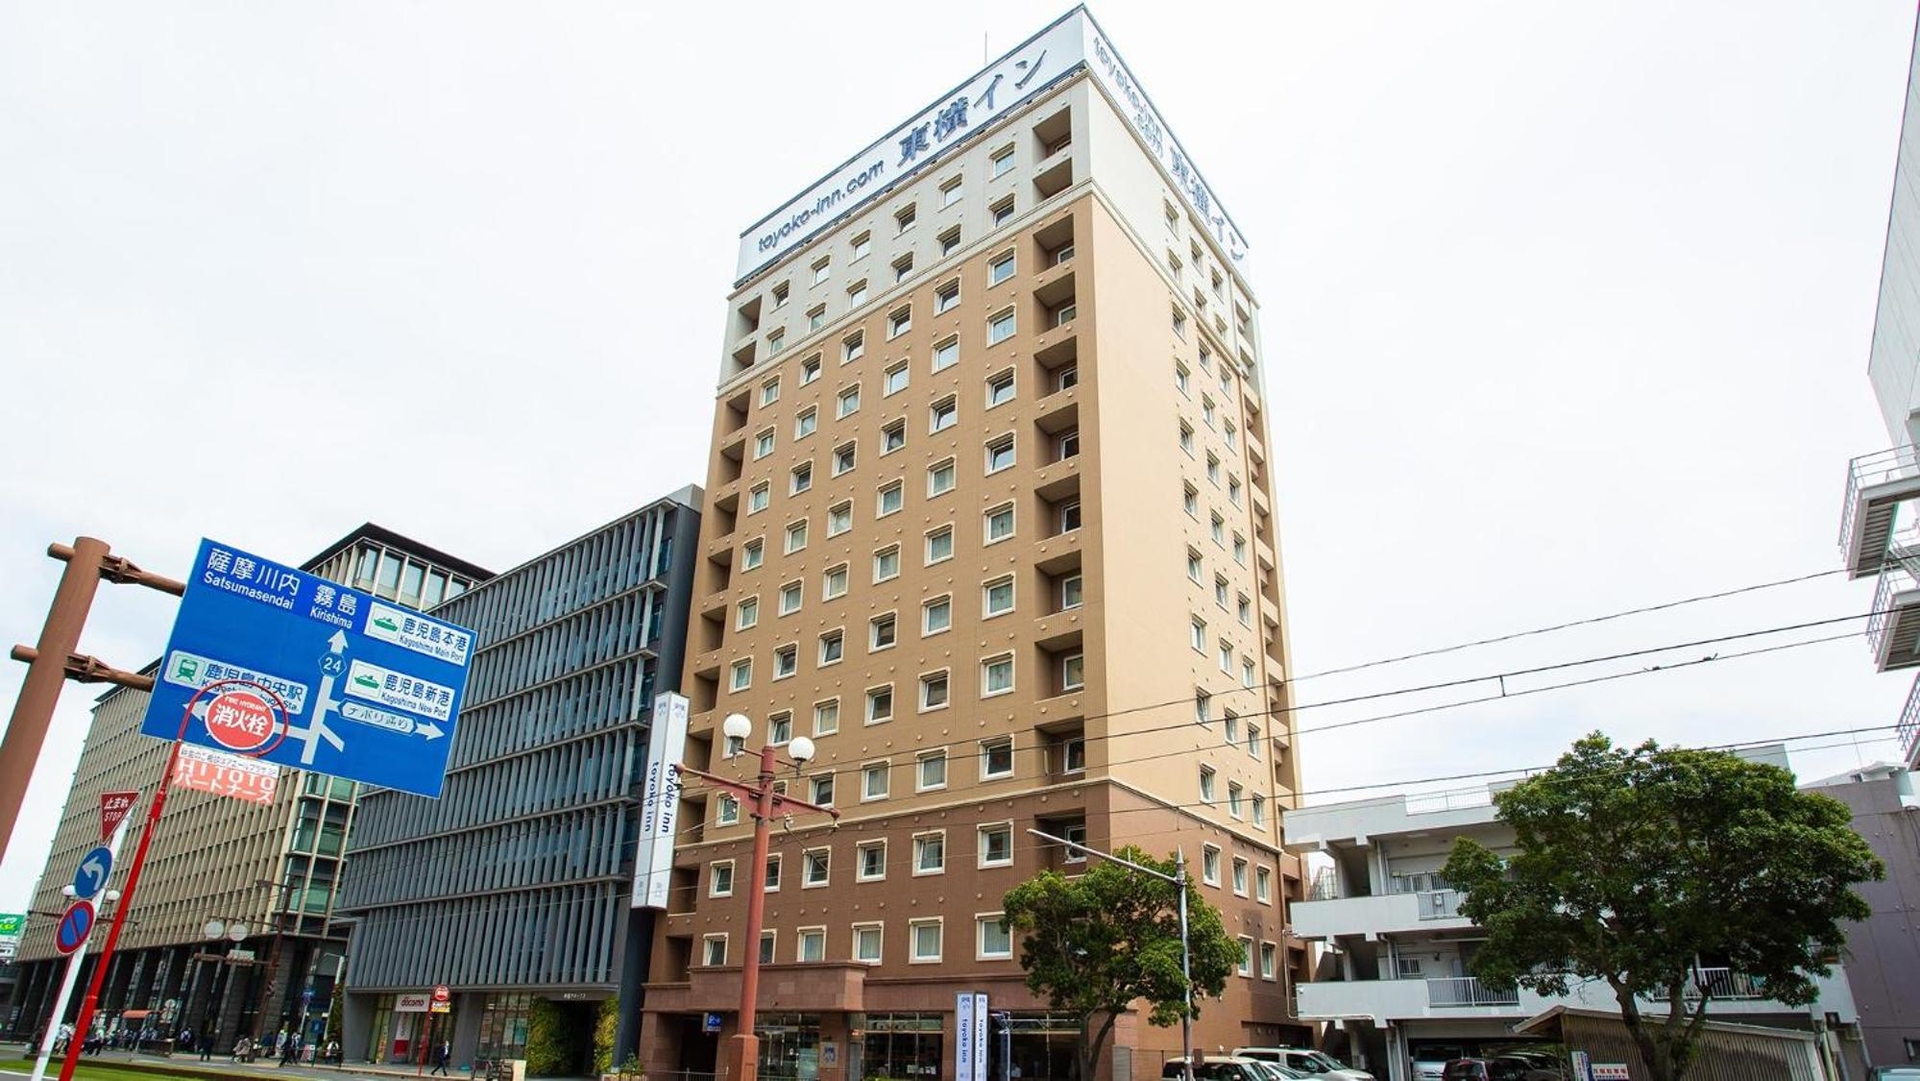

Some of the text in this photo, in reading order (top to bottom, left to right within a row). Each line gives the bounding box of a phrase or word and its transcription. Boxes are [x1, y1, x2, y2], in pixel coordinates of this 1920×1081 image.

[758, 49, 1047, 253] toyoko-inn.com 東横イン
[1170, 147, 1244, 261] 東横イン
[207, 548, 300, 596] 薩摩川内
[204, 571, 294, 610] Satsumasendai
[314, 584, 358, 616] 霧島
[310, 606, 353, 629] Kirishima
[399, 634, 465, 663] Kagoshima Main Port
[401, 617, 468, 652] 鹿児島本港
[323, 657, 341, 672] 24
[381, 691, 447, 718] Kagoshima New Port
[384, 674, 450, 707] 鹿児島新港
[212, 704, 268, 736] 消火栓
[179, 759, 275, 790] HITOTO
[104, 796, 129, 809] 止まれ
[645, 761, 659, 832] toyoko inn
[104, 811, 122, 822] STOP
[661, 812, 673, 833] inn
